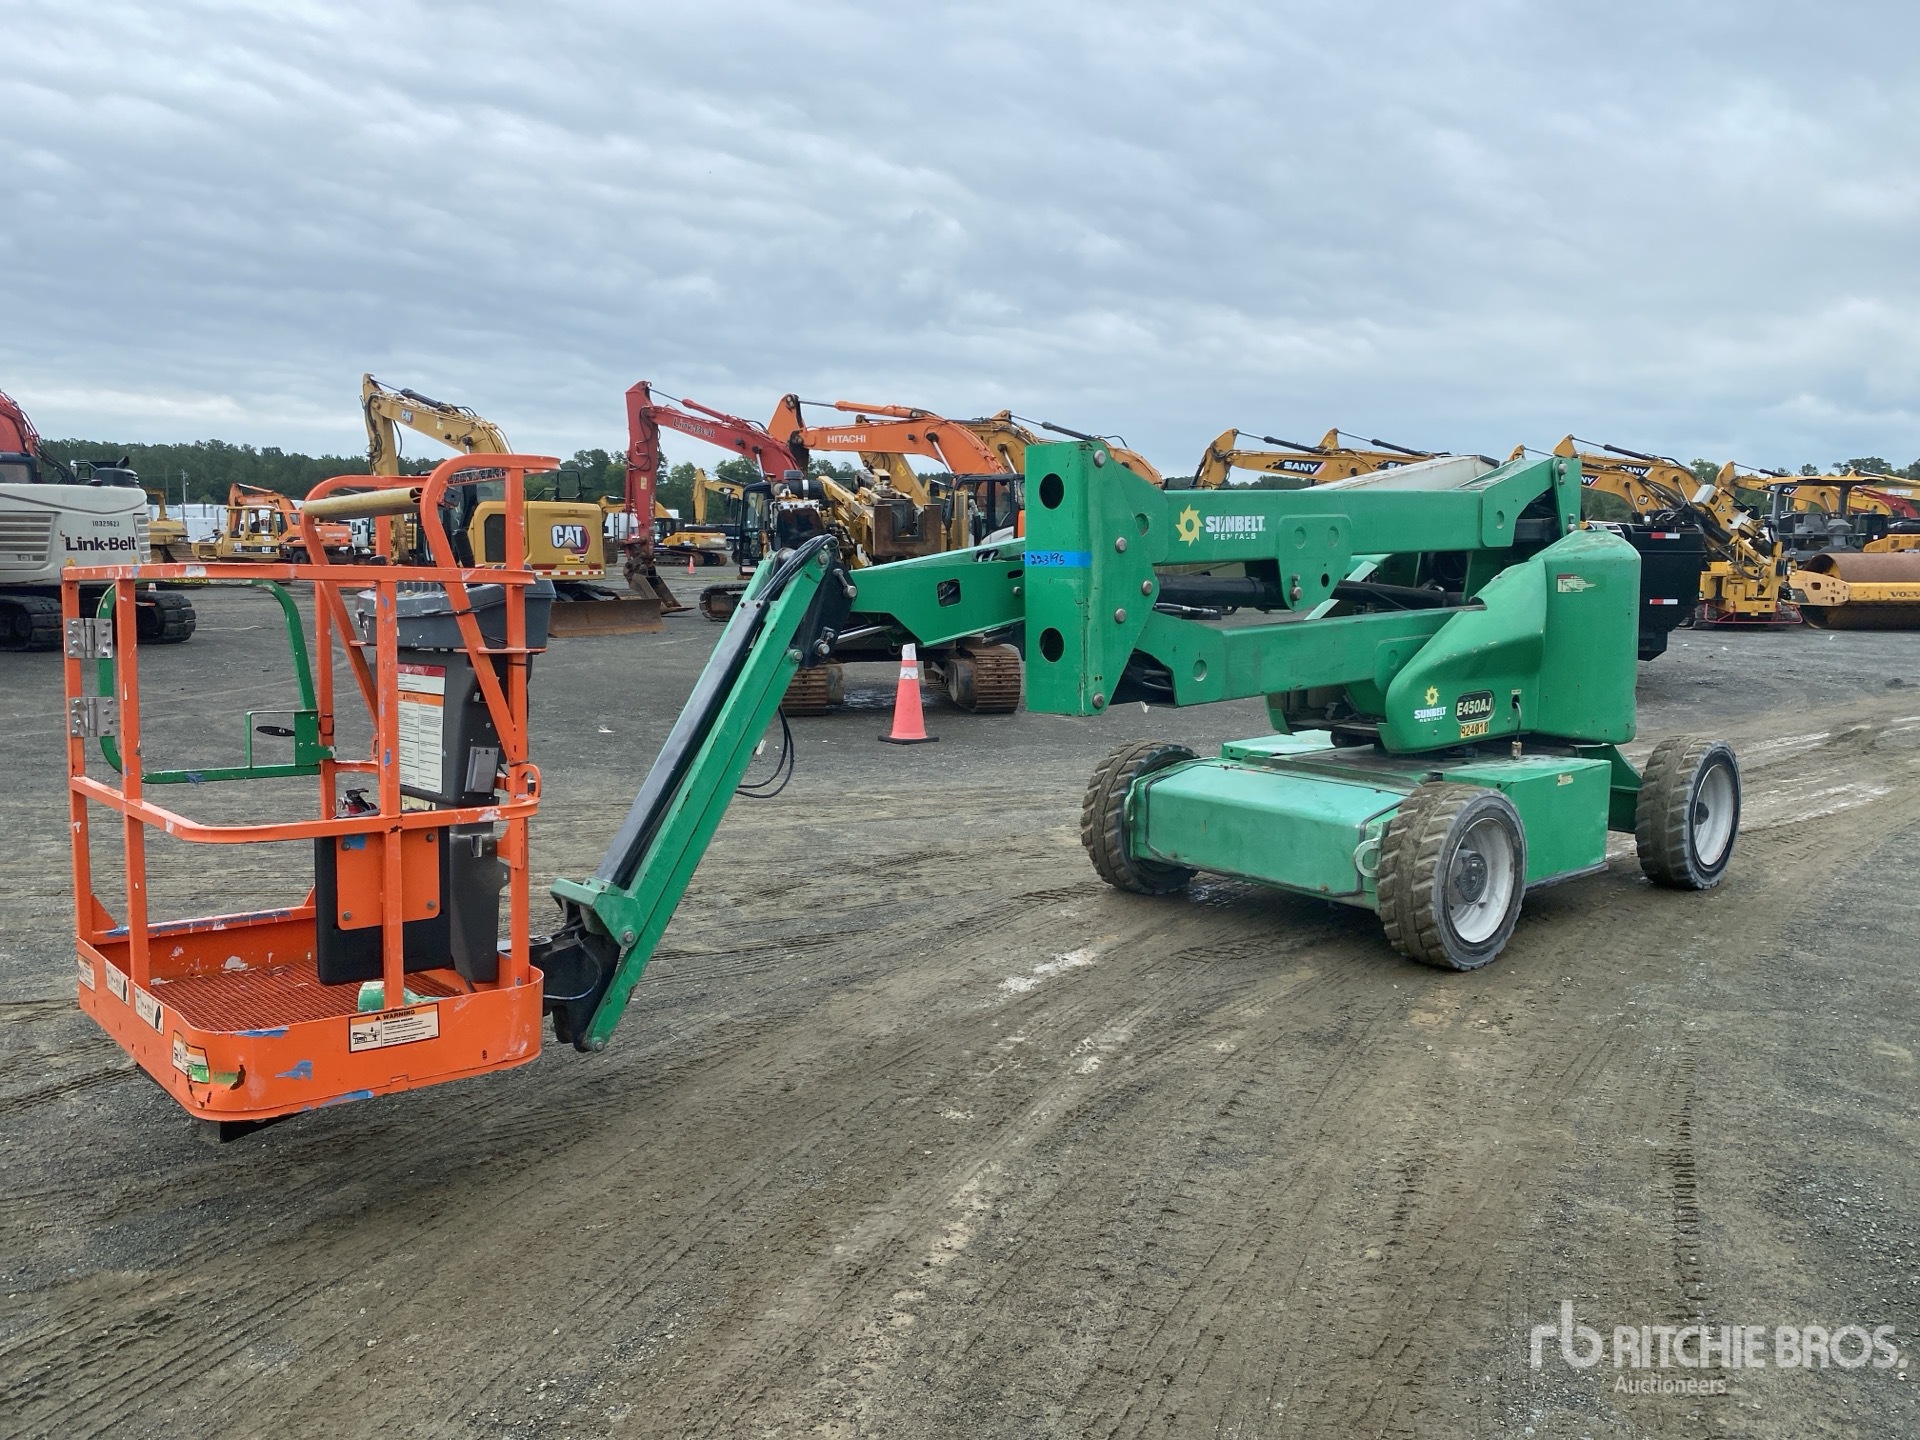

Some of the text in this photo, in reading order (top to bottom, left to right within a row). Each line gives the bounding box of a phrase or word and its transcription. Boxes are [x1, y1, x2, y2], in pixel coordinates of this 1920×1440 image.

[827, 435, 866, 444] HITACHI
[1283, 461, 1317, 472] SANY
[1205, 515, 1265, 533] SUNBELT
[65, 536, 137, 551] Link-Belt
[551, 525, 583, 548] CAT
[1414, 706, 1447, 720] SUNBELT
[1456, 698, 1492, 716] E450AJ
[383, 1009, 416, 1020] WARNING
